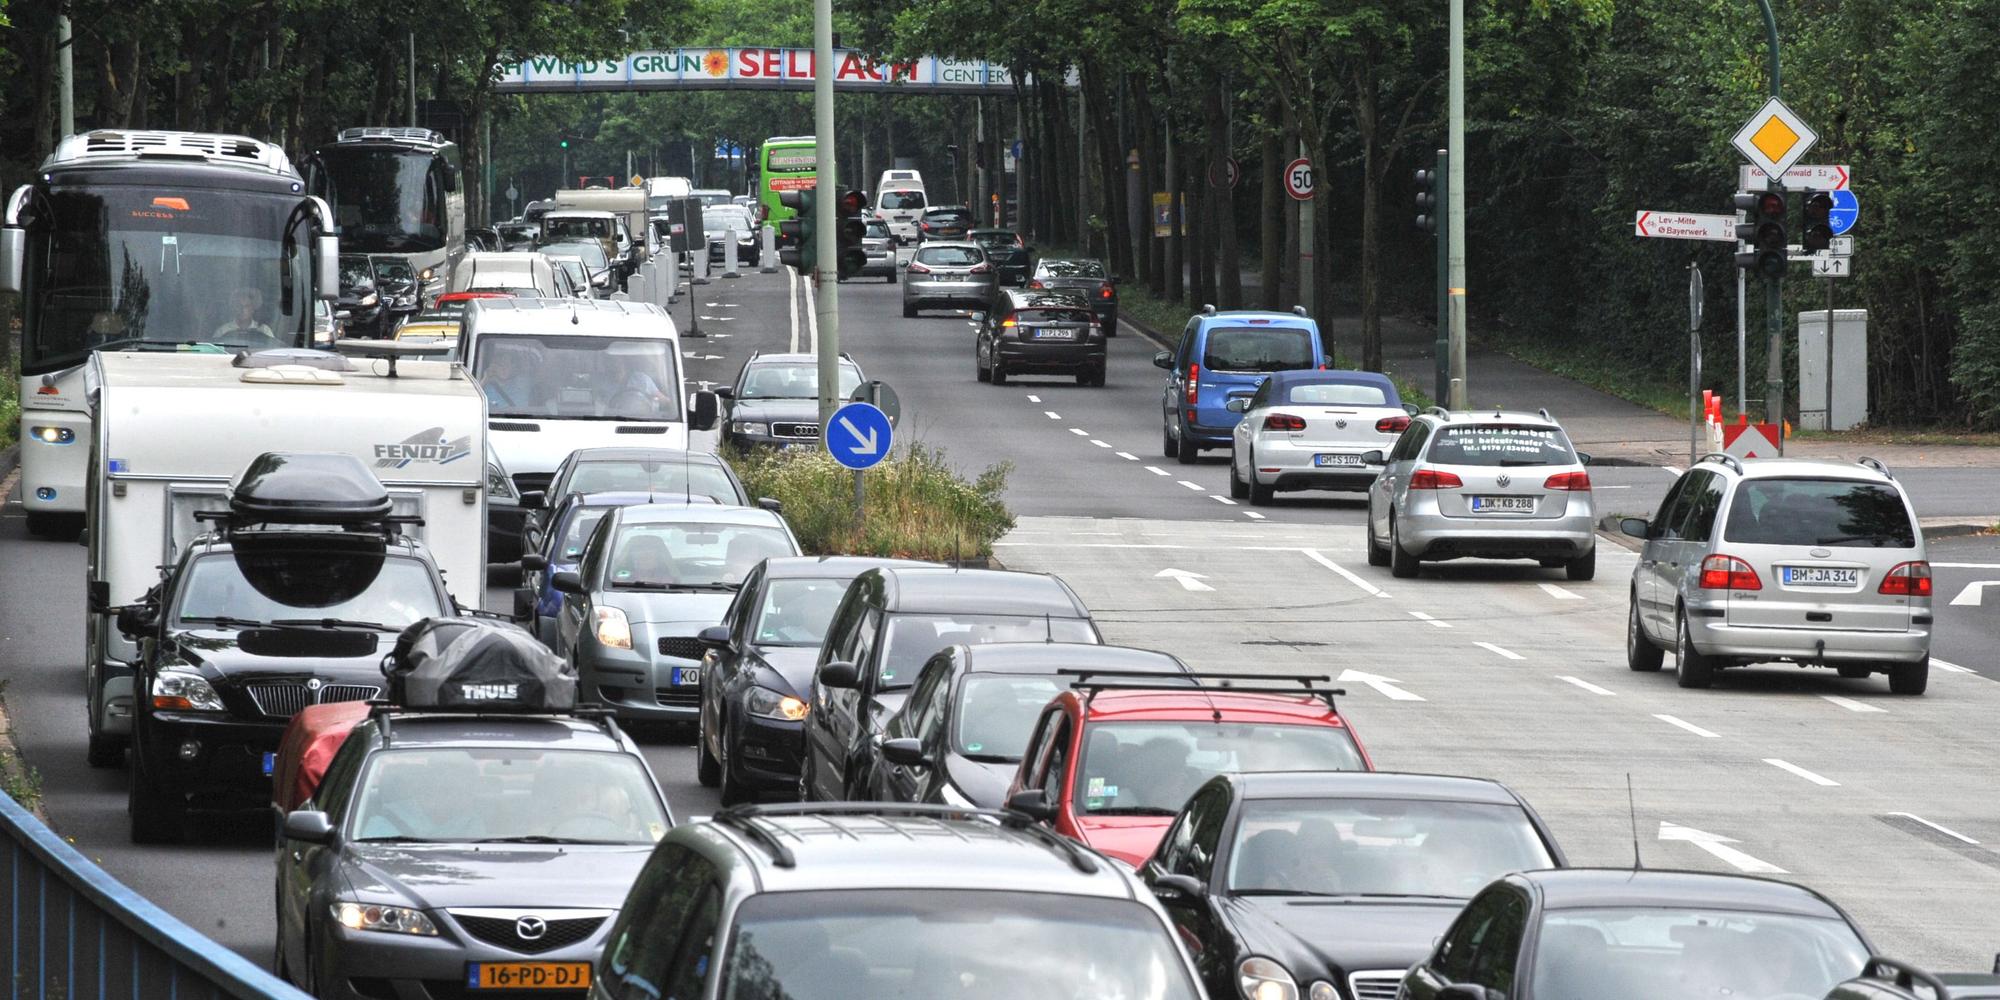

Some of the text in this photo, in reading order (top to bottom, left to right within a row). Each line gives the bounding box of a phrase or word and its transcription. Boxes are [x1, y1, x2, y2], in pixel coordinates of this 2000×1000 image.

[942, 69, 1005, 83] CENTER
[1293, 171, 1313, 188] 50
[1658, 216, 1697, 225] Lev.-Mitte
[1666, 227, 1708, 236] Bayerwerk
[374, 444, 454, 459] FENDT
[1480, 498, 1533, 509] LDK KB 288
[1791, 569, 1856, 583] BM JA 314
[680, 670, 698, 683] KO
[462, 684, 519, 699] THULE
[489, 967, 580, 985] 16-PD-DJ
